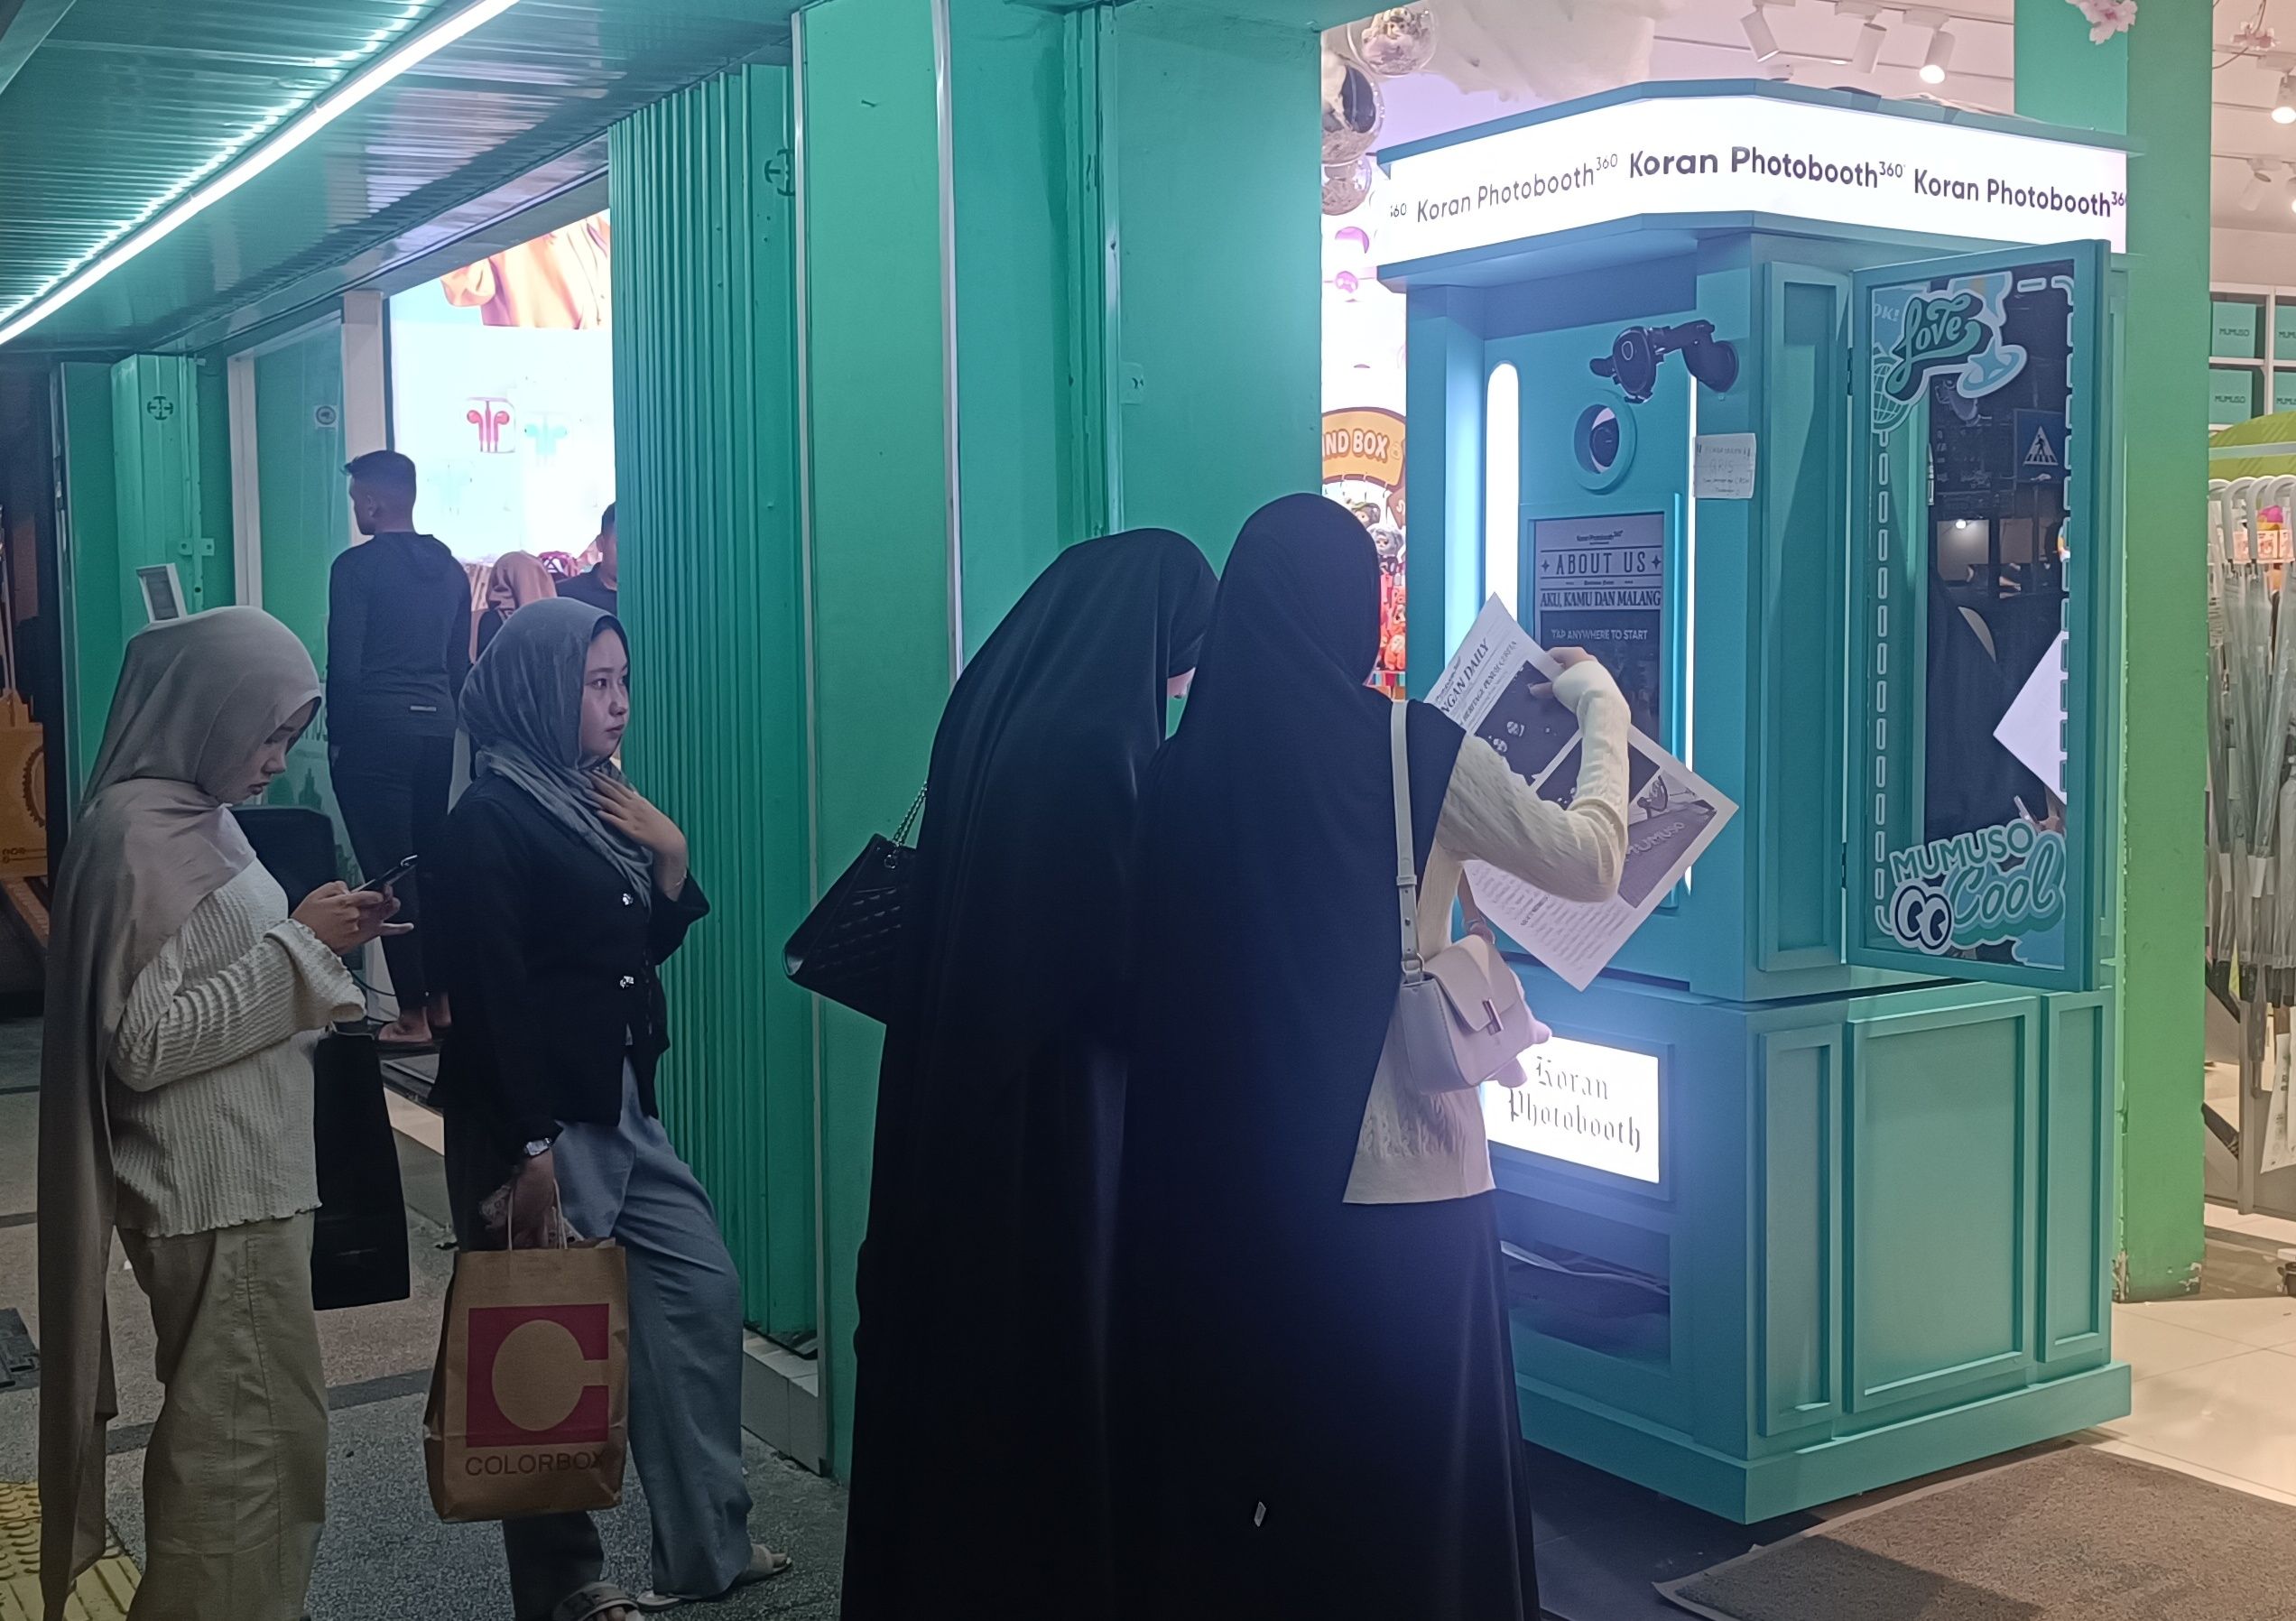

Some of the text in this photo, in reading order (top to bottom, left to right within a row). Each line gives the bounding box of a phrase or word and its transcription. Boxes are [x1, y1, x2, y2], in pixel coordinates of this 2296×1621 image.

[1417, 196, 1471, 223] Koran
[1629, 150, 1718, 179] Koran
[1914, 168, 1979, 202] Koran
[2218, 328, 2250, 338] MUMUSO
[2214, 395, 2246, 404] MUMUSO
[1352, 427, 1391, 464] BOX
[1555, 551, 1646, 576] ABOUT US
[1563, 590, 1593, 607] KAMU
[1594, 590, 1616, 607] DAN
[1617, 589, 1662, 607] MALANG
[1551, 629, 1649, 641] TAP ANYWHERE TO START
[1466, 635, 1491, 683] DAILY
[1890, 820, 2034, 885] MUMUSO
[1948, 840, 2058, 927] Cool
[1535, 1054, 1609, 1101] Koran
[1508, 1088, 1642, 1153] Photobooth
[465, 1450, 606, 1477] COLORBOX
